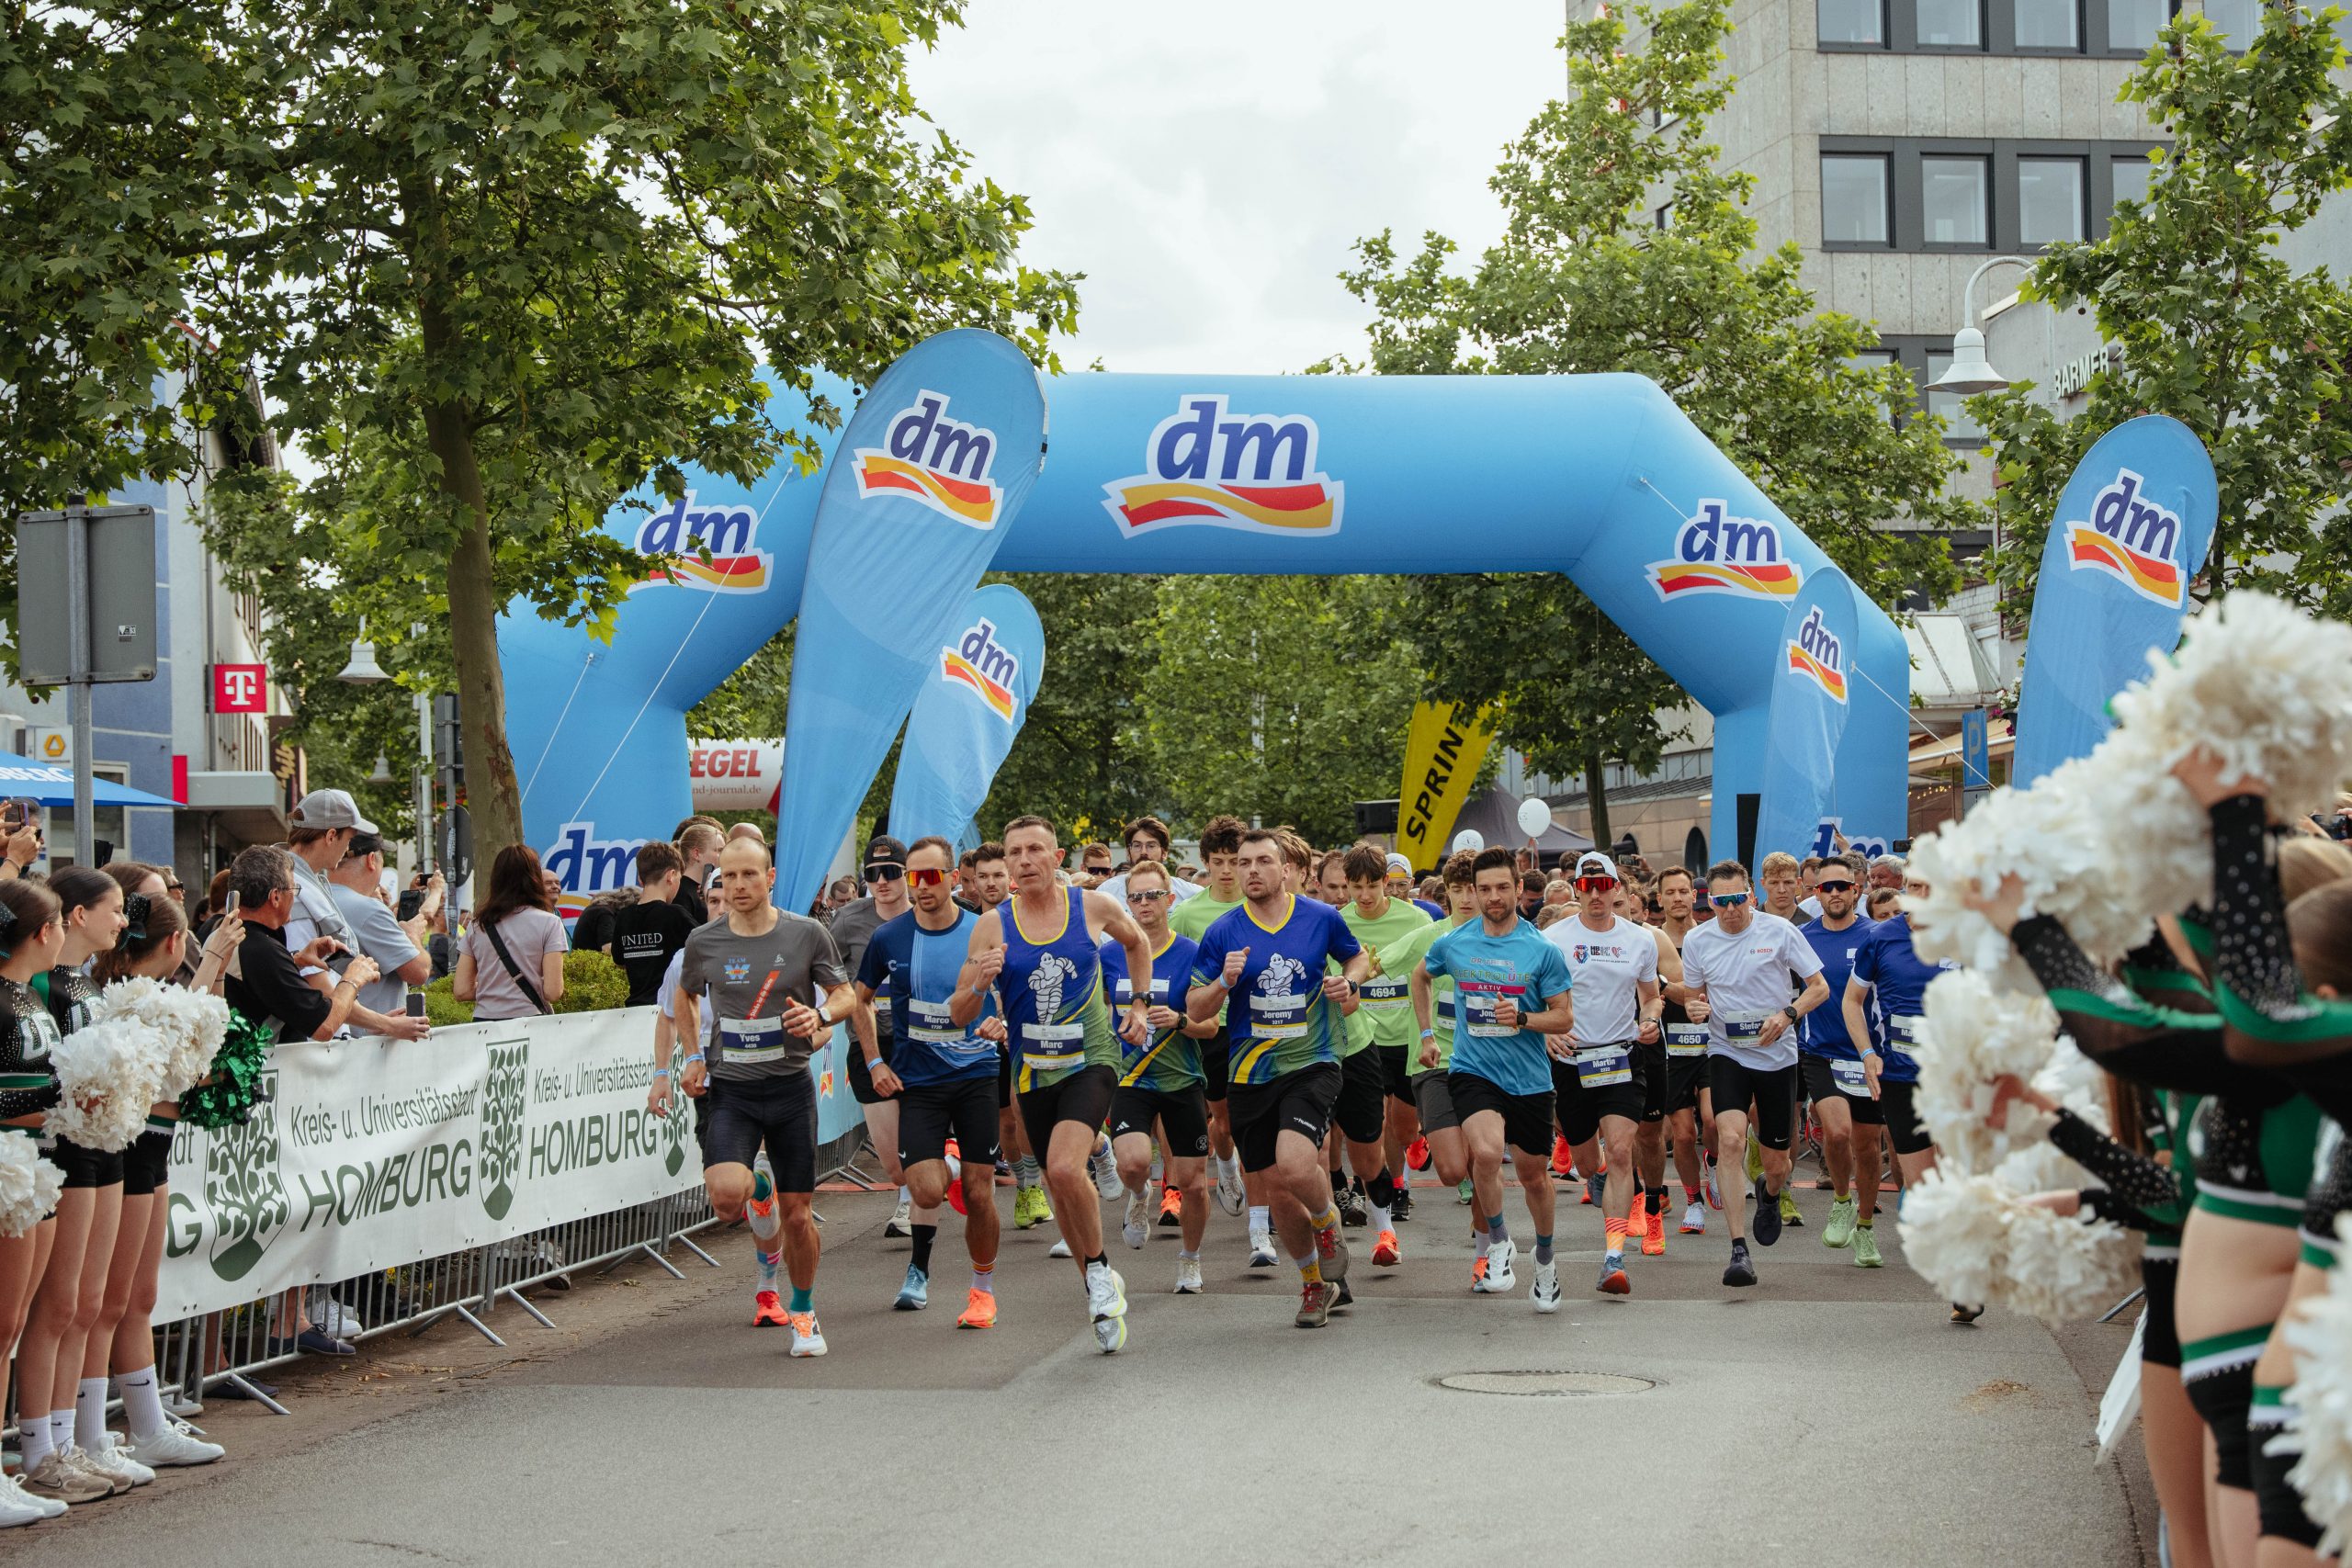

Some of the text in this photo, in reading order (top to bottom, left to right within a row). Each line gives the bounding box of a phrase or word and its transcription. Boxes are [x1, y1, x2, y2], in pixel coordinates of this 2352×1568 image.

[889, 397, 991, 481] dm
[1157, 400, 1308, 480] dm
[640, 496, 751, 554] dm
[1681, 504, 1777, 562] dm
[2095, 476, 2176, 561] dm
[961, 623, 1015, 689] dm
[1801, 610, 1839, 671] dm
[224, 671, 256, 705] T
[1967, 721, 1982, 777] P
[545, 829, 647, 892] dm
[621, 932, 663, 946] UNITED
[924, 1014, 950, 1024] Marco
[1262, 1010, 1293, 1020] Jeremy
[1370, 987, 1396, 998] 4694
[739, 1033, 761, 1043] Yves
[1040, 1040, 1064, 1049] Marc
[1592, 1057, 1616, 1068] Martin
[1678, 1034, 1702, 1044] 4650
[533, 1066, 562, 1104] Kreis-
[563, 1079, 574, 1100] u.
[1844, 1071, 1864, 1080] Oliver
[289, 1078, 481, 1148] Kreis- u. Universitätsstadt
[528, 1108, 658, 1180] HOMBURG
[298, 1138, 473, 1234] HOMBURG
